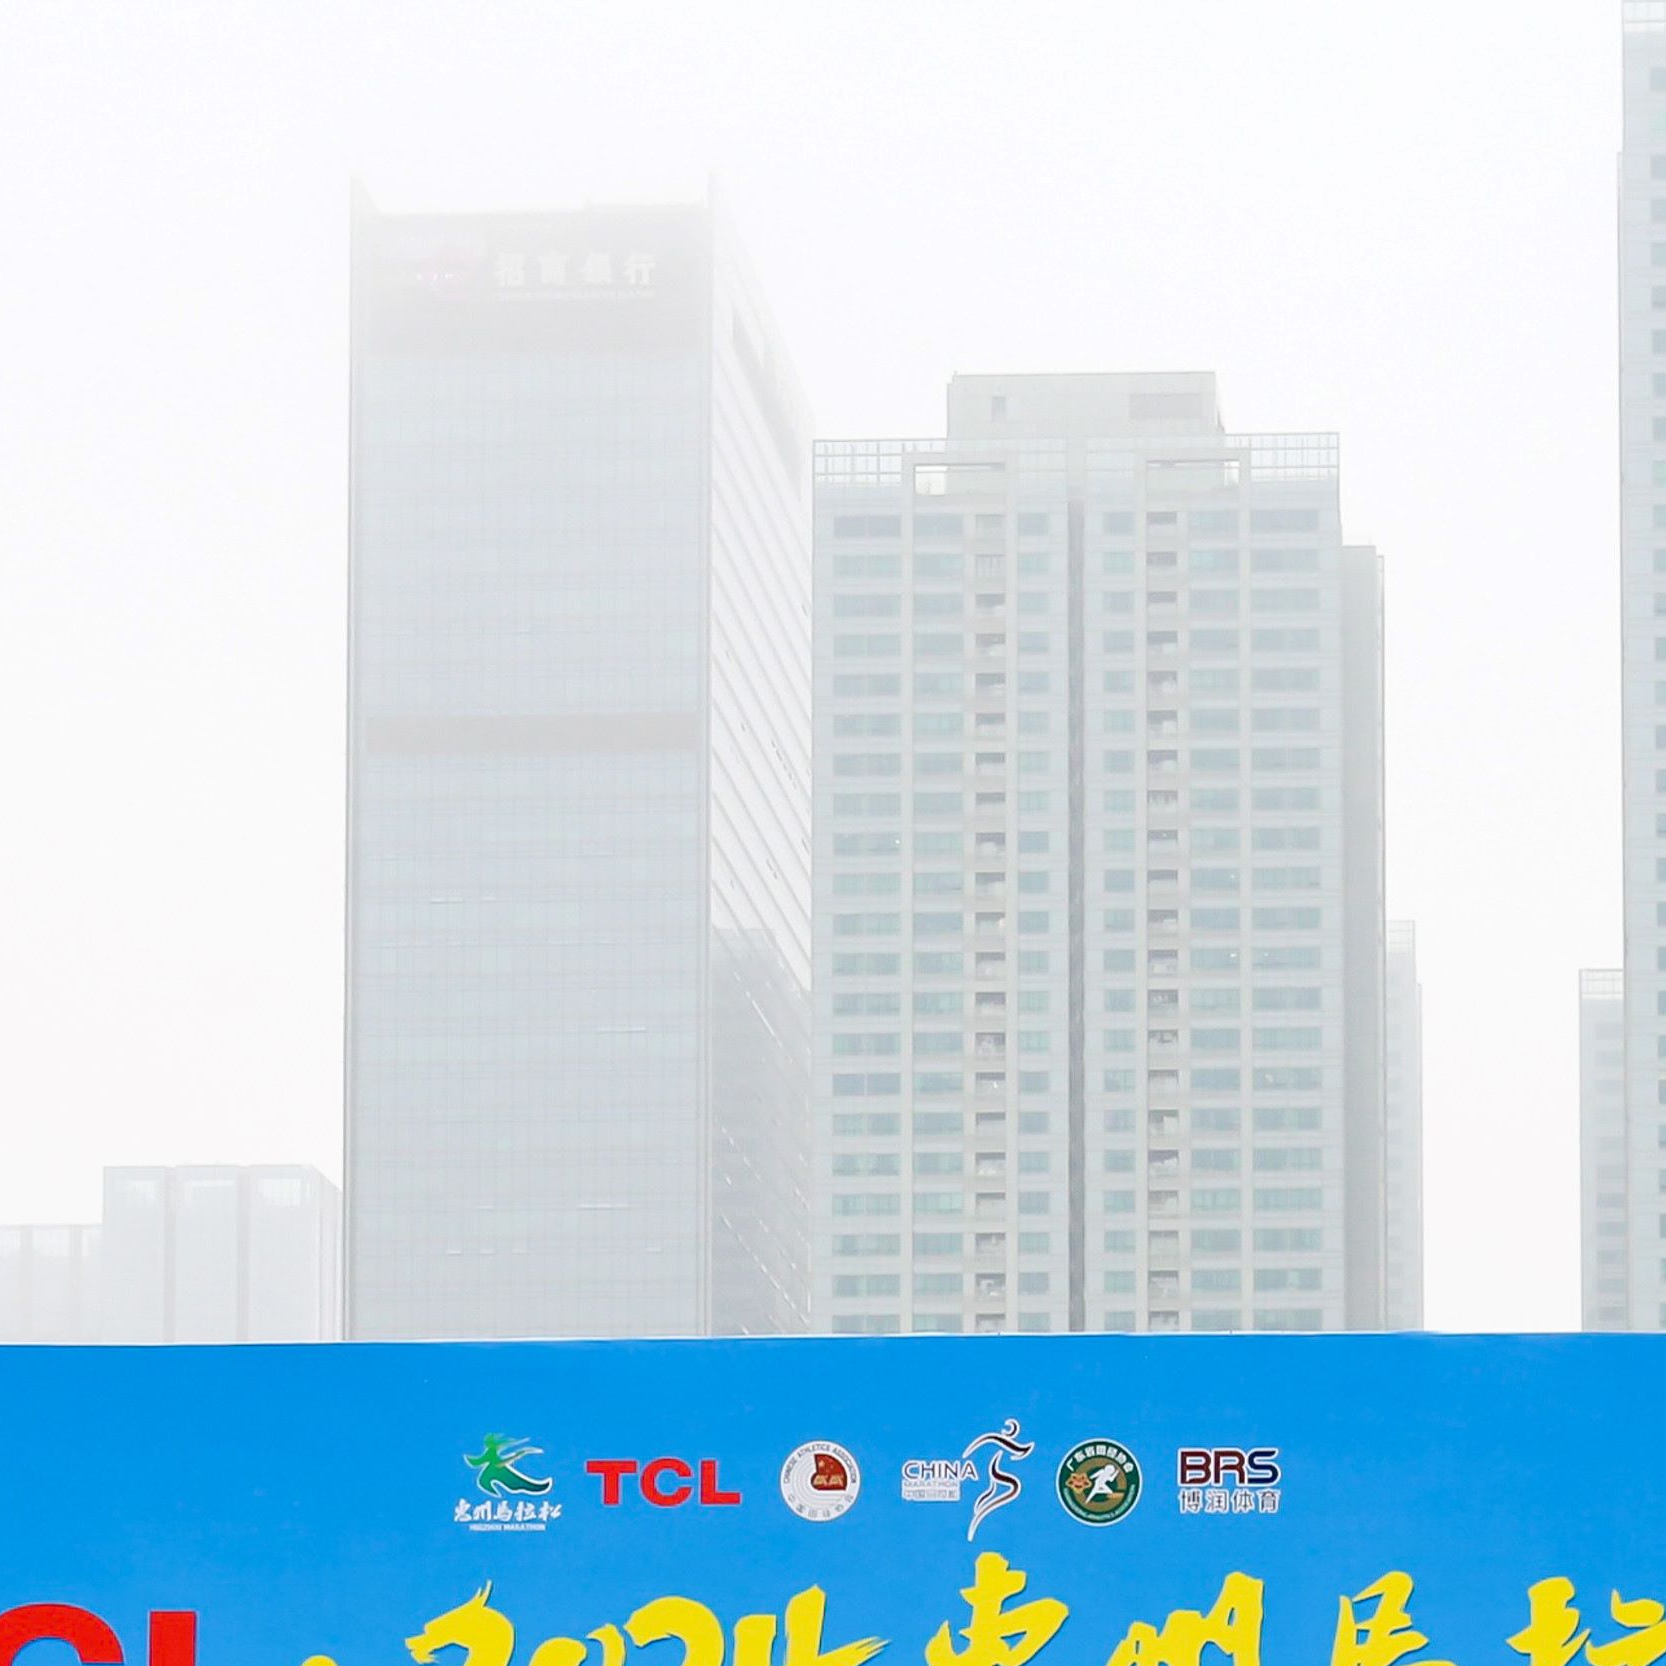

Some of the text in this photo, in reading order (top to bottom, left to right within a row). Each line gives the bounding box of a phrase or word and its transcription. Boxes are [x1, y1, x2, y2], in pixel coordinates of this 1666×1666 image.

[585, 1457, 742, 1508] TCL
[903, 1460, 978, 1481] CHINA
[1178, 1448, 1280, 1486] BRS
[1178, 1488, 1281, 1514] 博润体育
